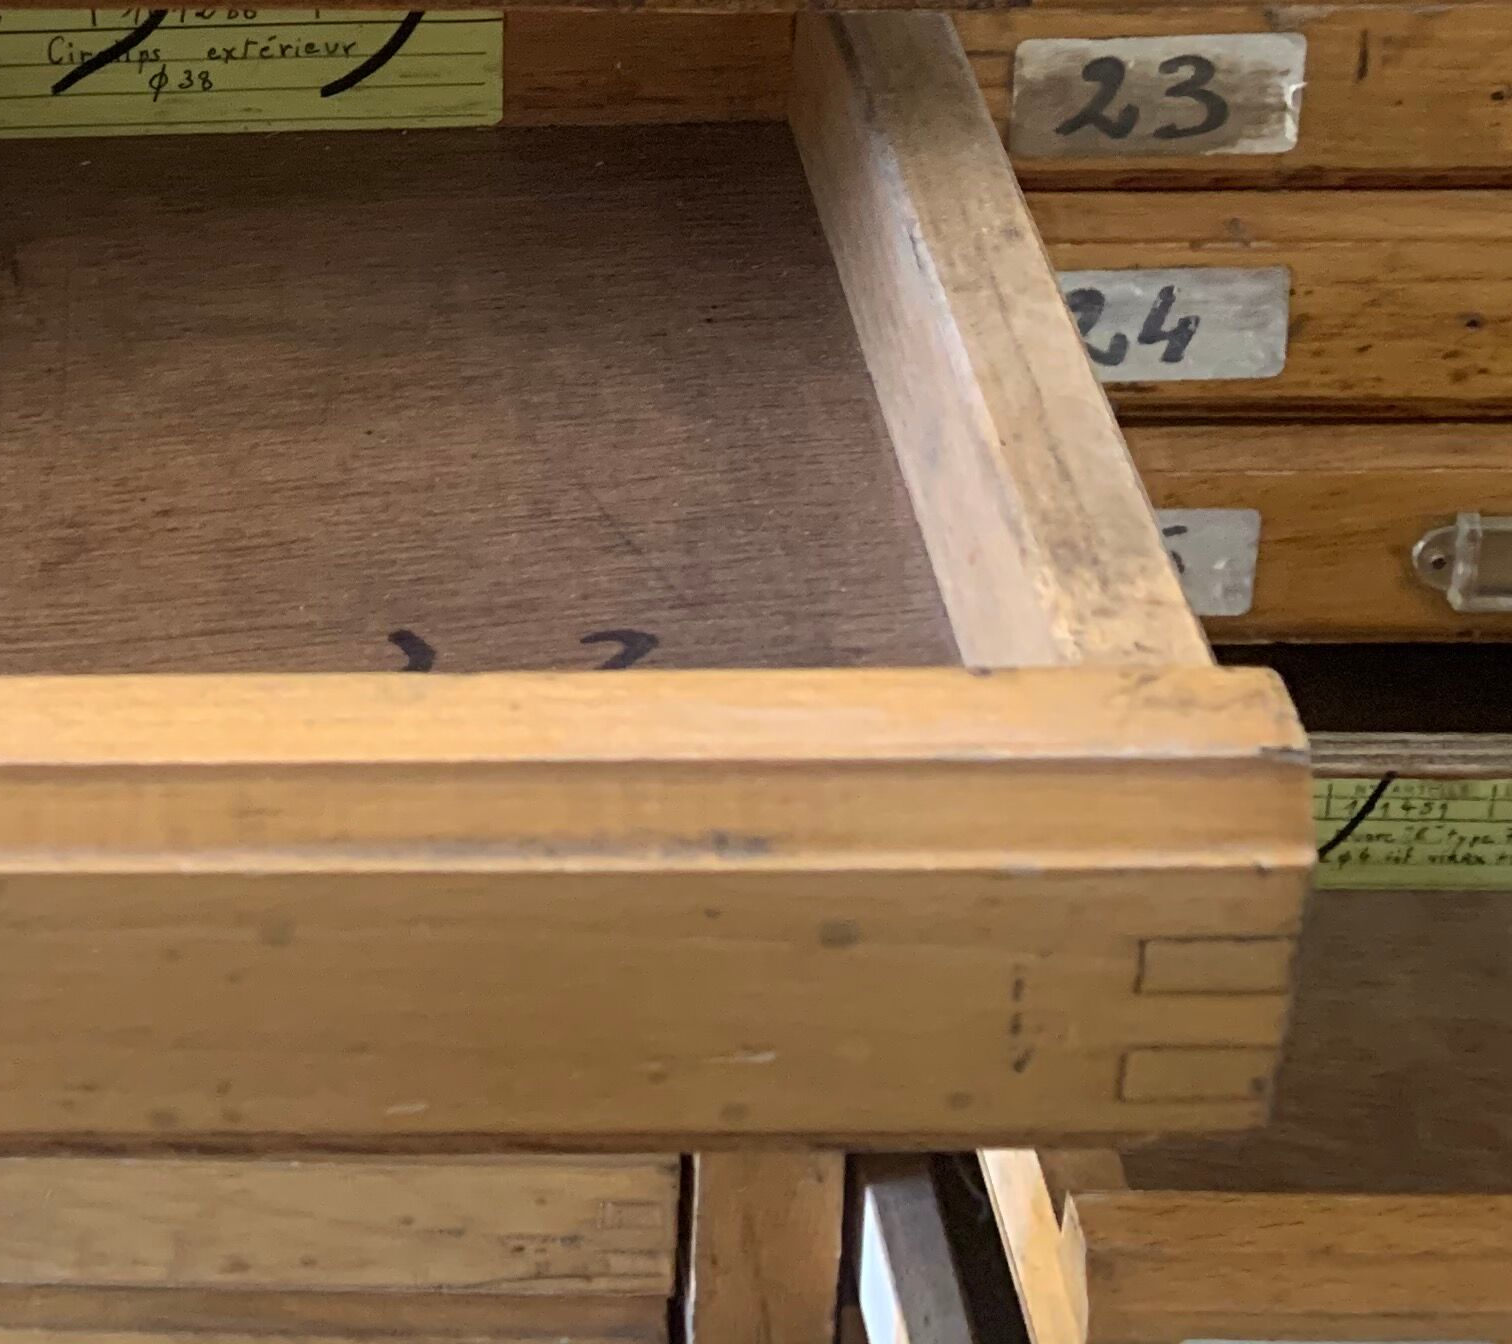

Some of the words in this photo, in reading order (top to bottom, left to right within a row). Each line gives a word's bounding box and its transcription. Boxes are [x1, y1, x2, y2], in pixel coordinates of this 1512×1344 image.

[207, 35, 357, 64] extérieur
[1053, 53, 1231, 140] 23
[1066, 284, 1201, 367] 24
